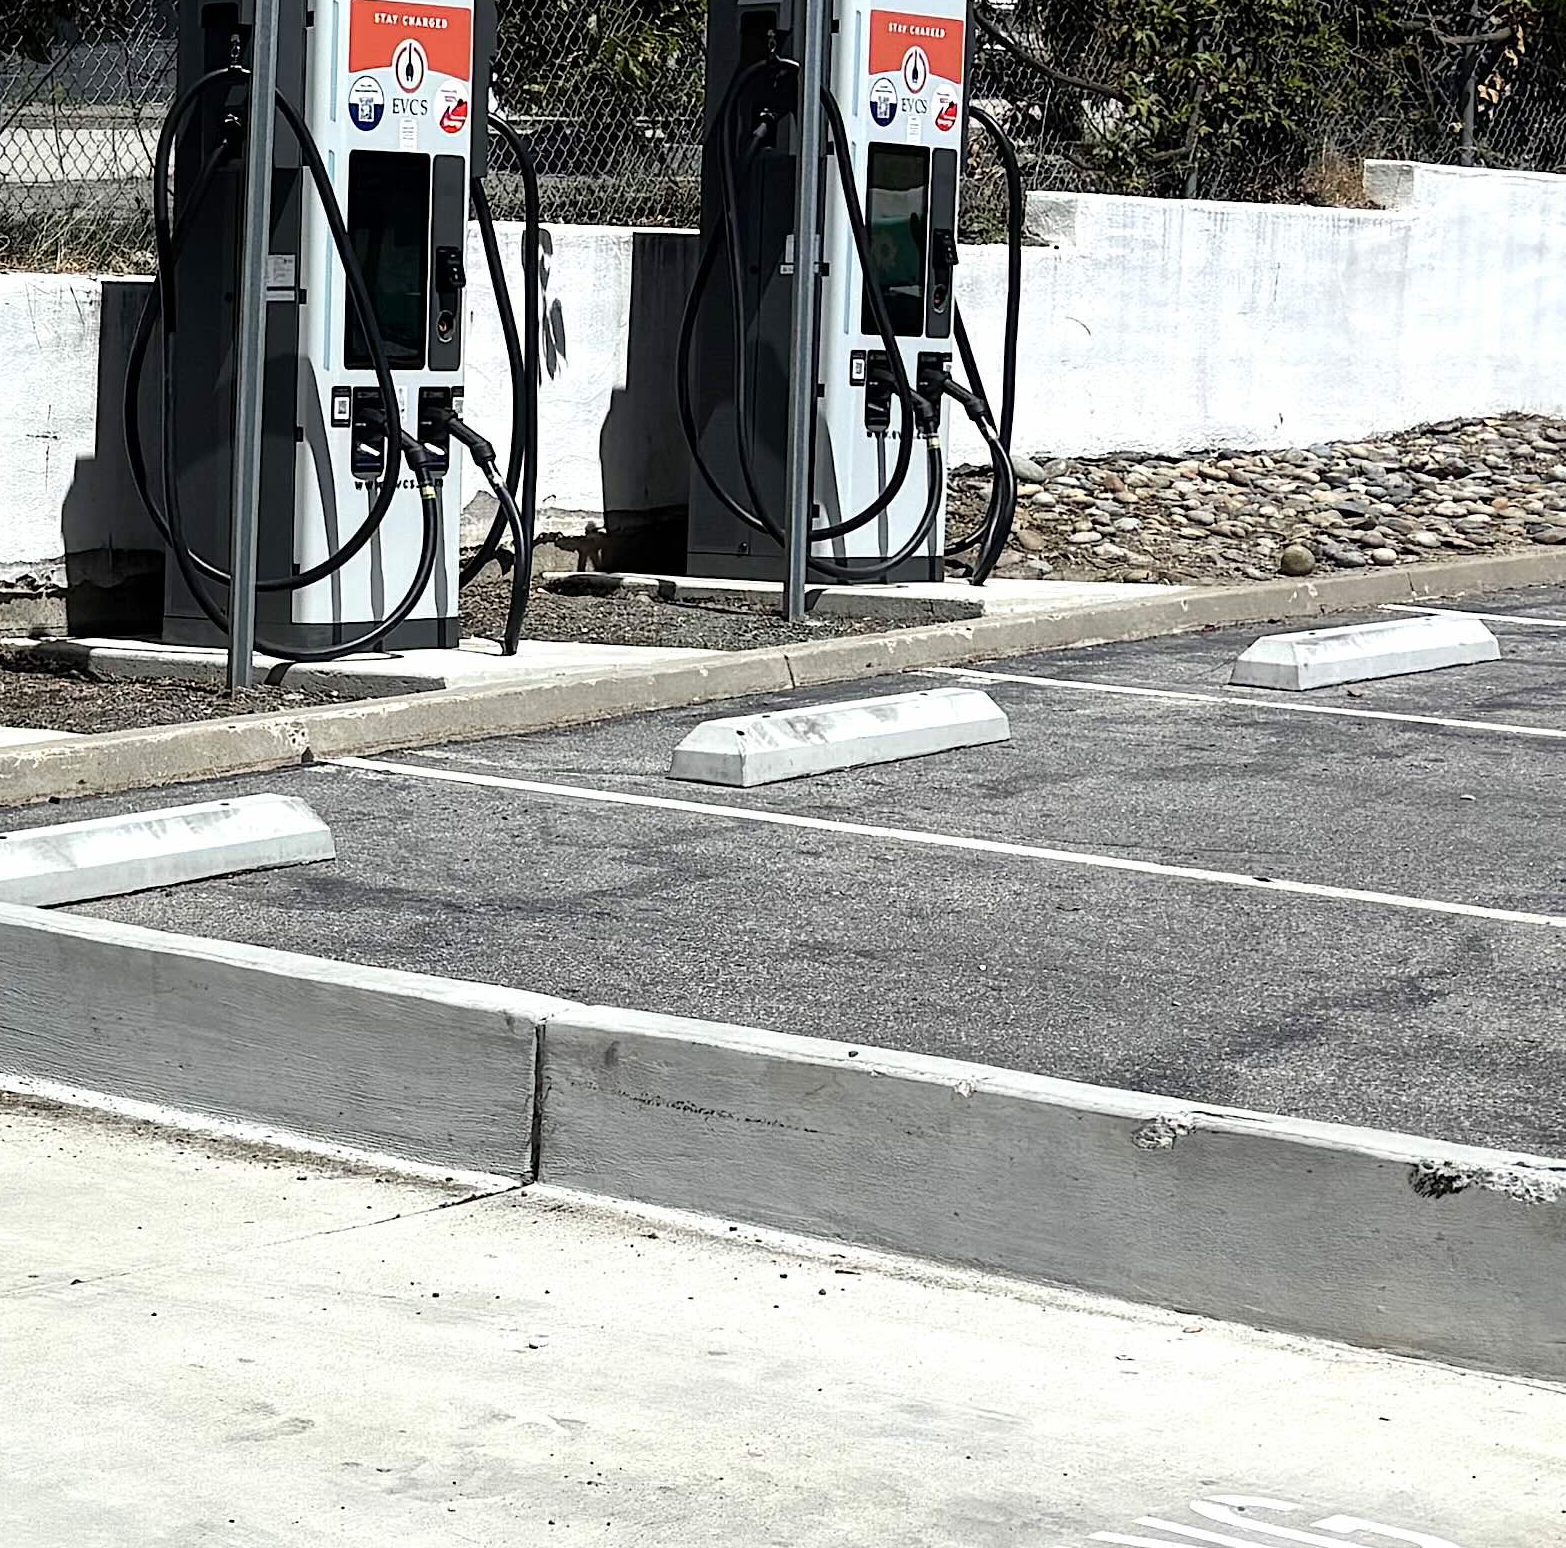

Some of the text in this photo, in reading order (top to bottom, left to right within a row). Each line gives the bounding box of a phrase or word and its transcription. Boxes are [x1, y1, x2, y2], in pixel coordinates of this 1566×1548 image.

[374, 12, 448, 30] STAY CHARGED
[392, 97, 429, 116] EVCS
[901, 97, 928, 114] EVCS
